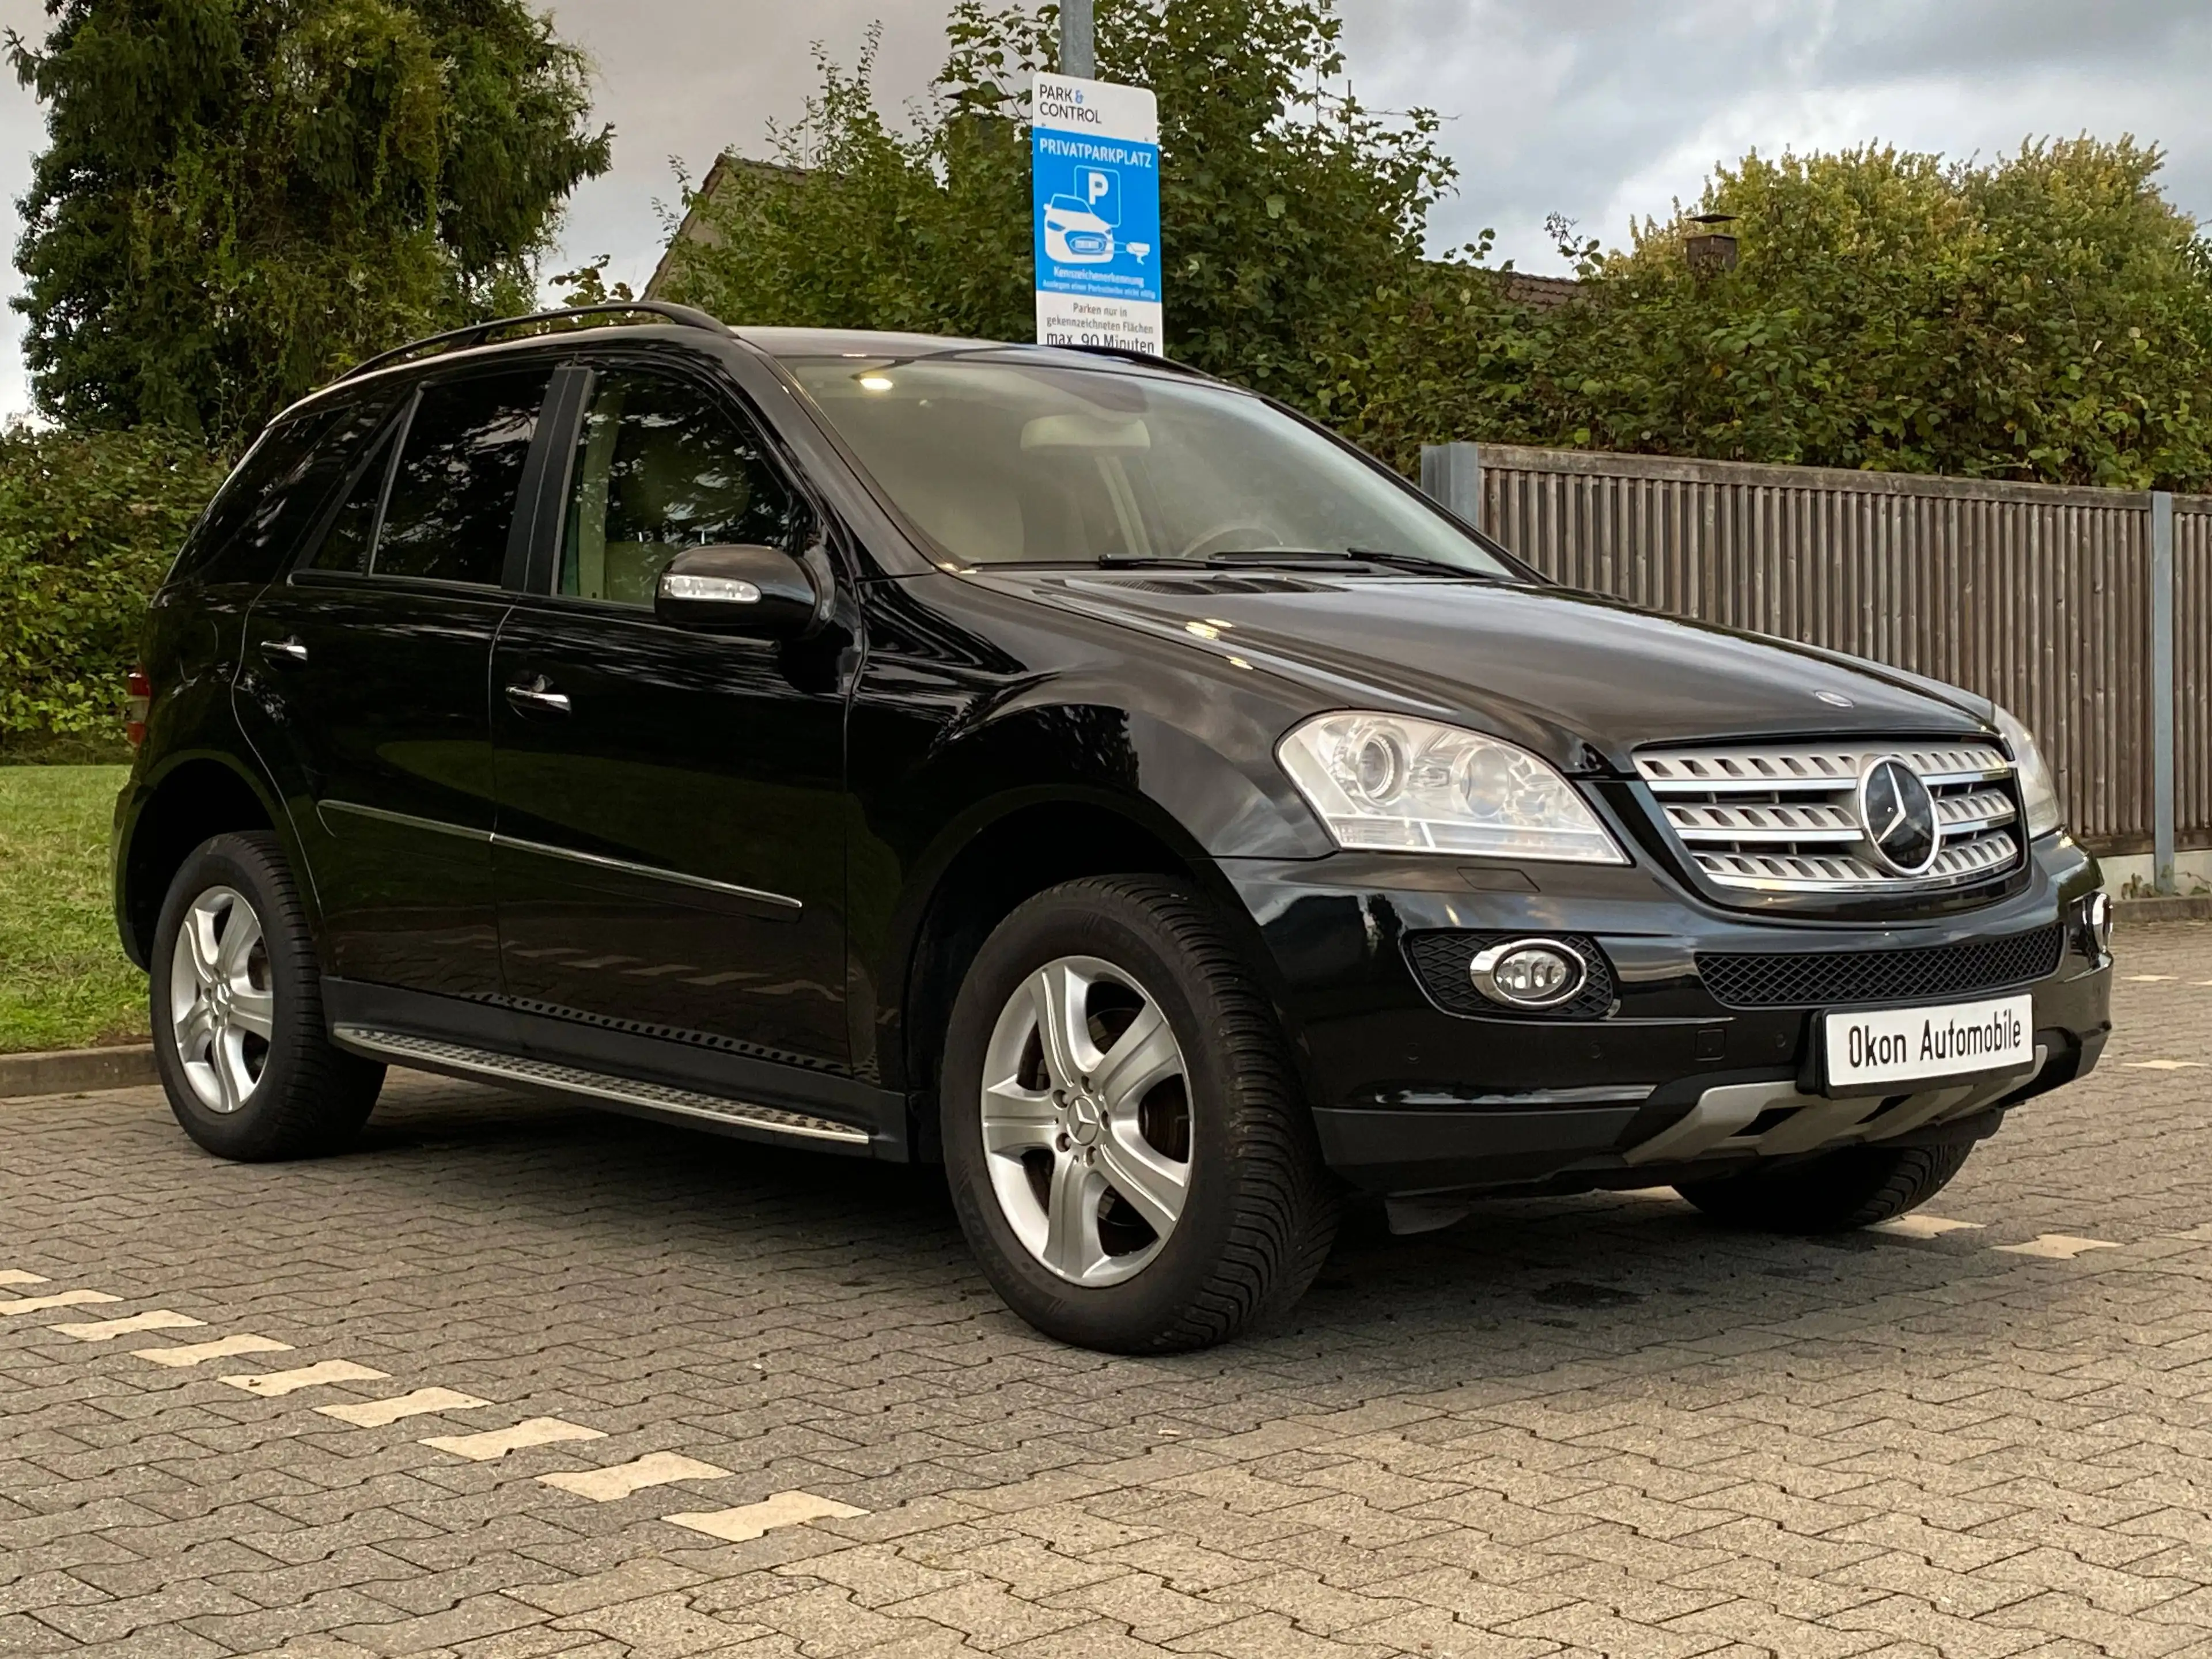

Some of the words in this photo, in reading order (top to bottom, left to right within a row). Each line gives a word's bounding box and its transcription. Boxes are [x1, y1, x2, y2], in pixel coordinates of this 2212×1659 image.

[1039, 84, 1073, 103] PARK
[1075, 90, 1084, 104] &
[1039, 102, 1102, 124] CONTROL
[1039, 137, 1152, 168] PRIVATPARKPLATZ
[1088, 172, 1108, 205] P
[1073, 302, 1101, 315] Parken
[1104, 308, 1117, 316] nur
[1120, 306, 1127, 317] in
[1047, 315, 1120, 331] gekennzeichneten
[1123, 321, 1153, 334] Flächen
[1081, 332, 1100, 346] 90
[1104, 334, 1154, 354] Minuten
[1849, 1025, 1907, 1068] Okon
[1920, 1009, 2021, 1061] Automobile
